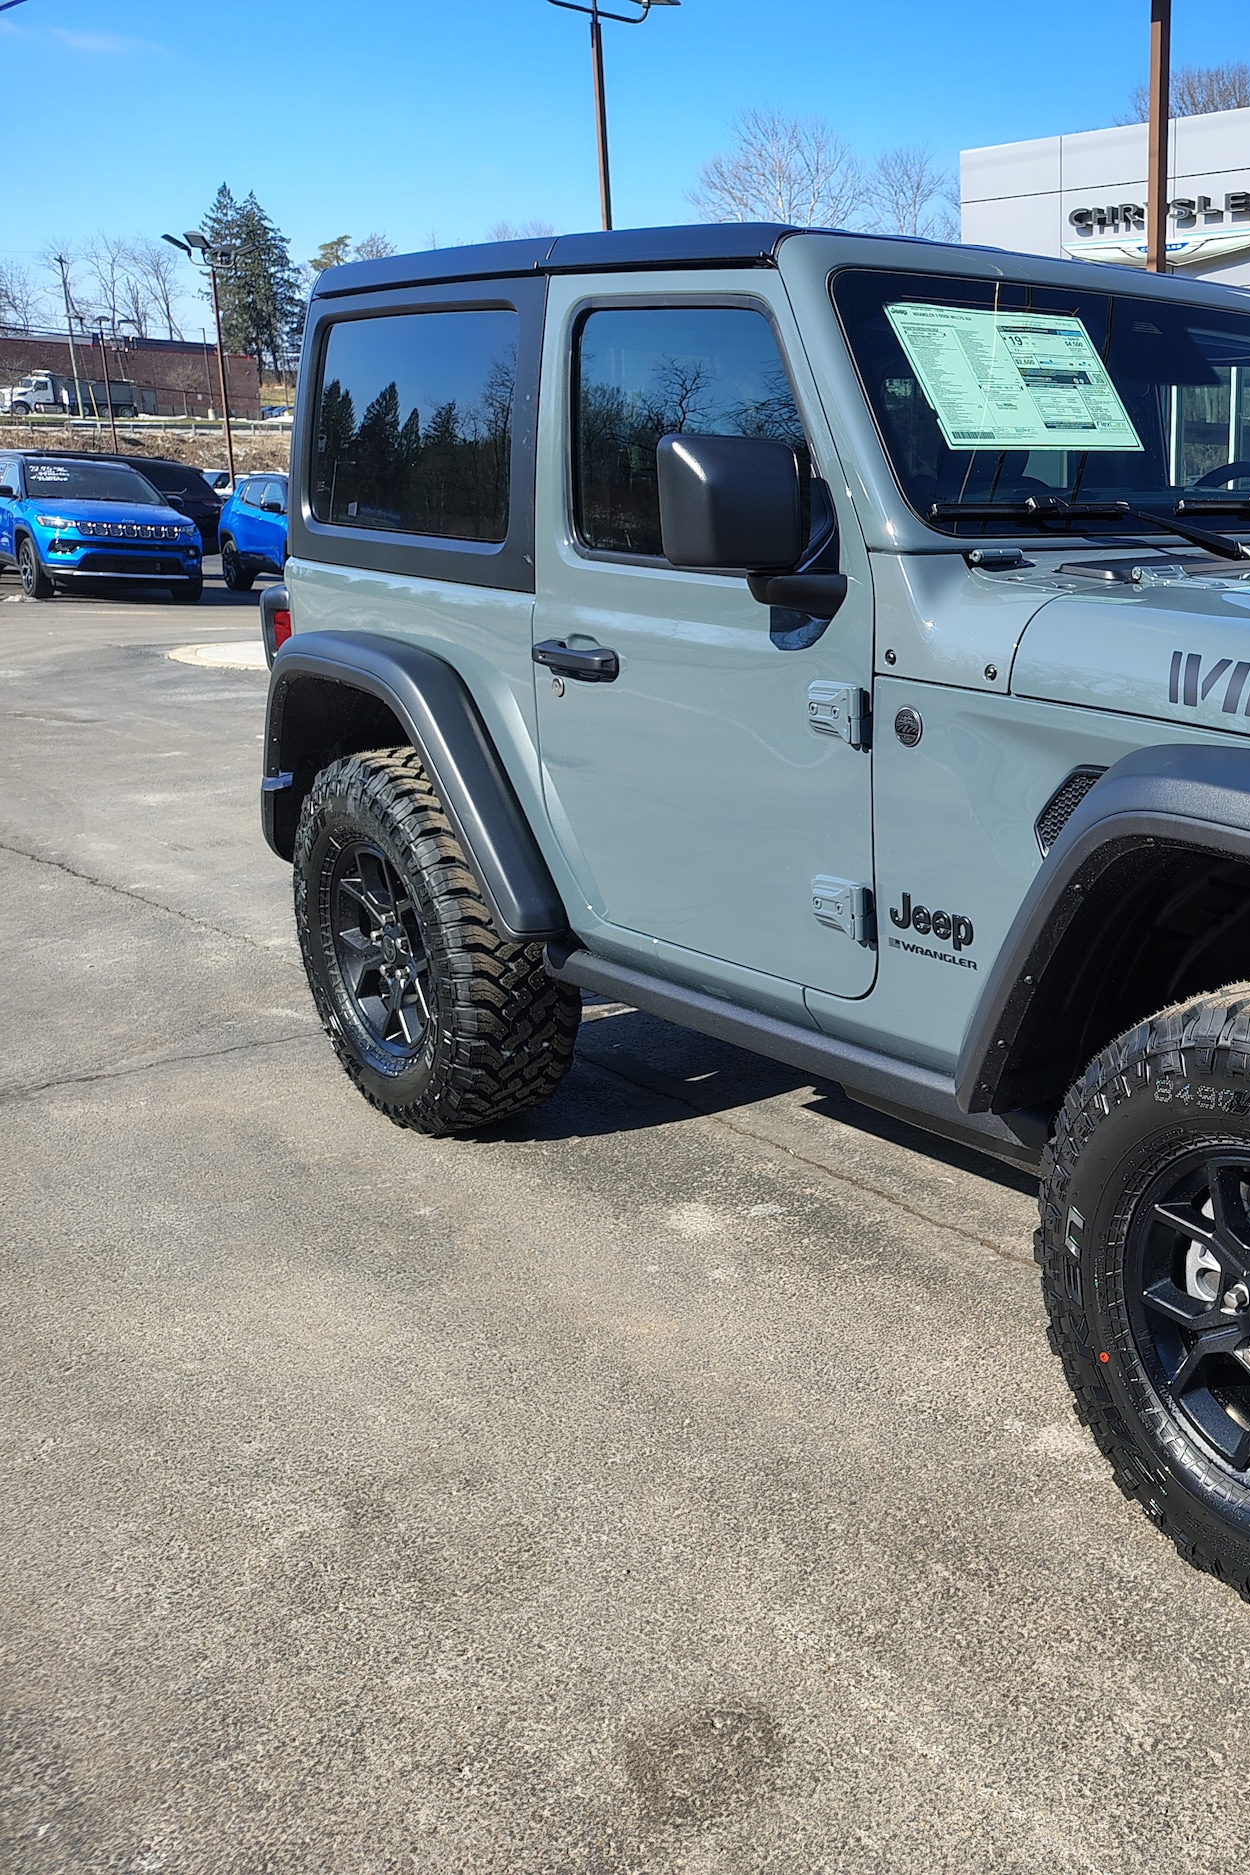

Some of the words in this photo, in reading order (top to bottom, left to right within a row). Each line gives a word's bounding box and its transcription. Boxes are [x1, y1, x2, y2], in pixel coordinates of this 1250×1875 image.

[1008, 335, 1023, 346] 19
[889, 891, 974, 952] Jeep
[901, 940, 978, 971] WRANGLER
